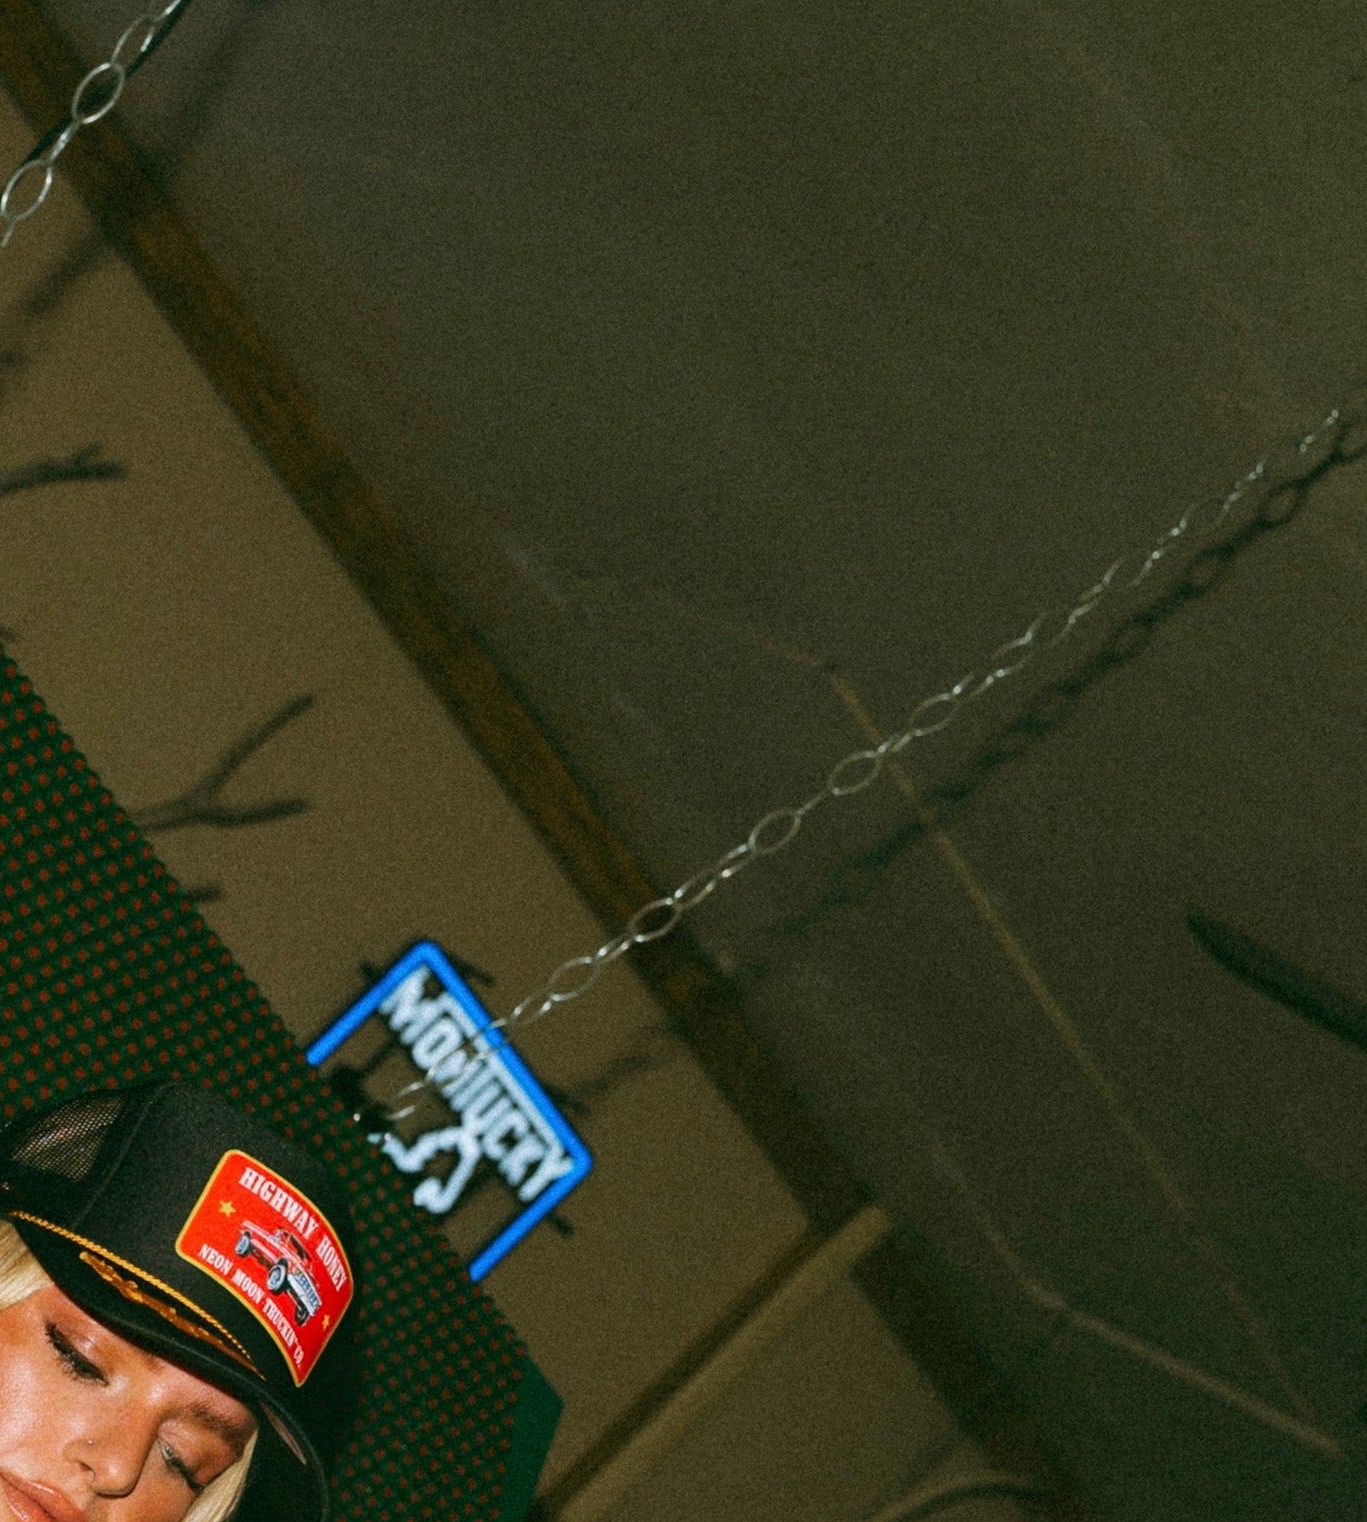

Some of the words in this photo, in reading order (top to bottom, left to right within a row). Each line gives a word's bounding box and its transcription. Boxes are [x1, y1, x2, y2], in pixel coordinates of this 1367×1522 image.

[198, 1243, 235, 1276] NEON
[232, 1268, 266, 1304] MOON
[238, 1167, 319, 1239] HIGHWAY
[315, 1236, 348, 1292] HONEY
